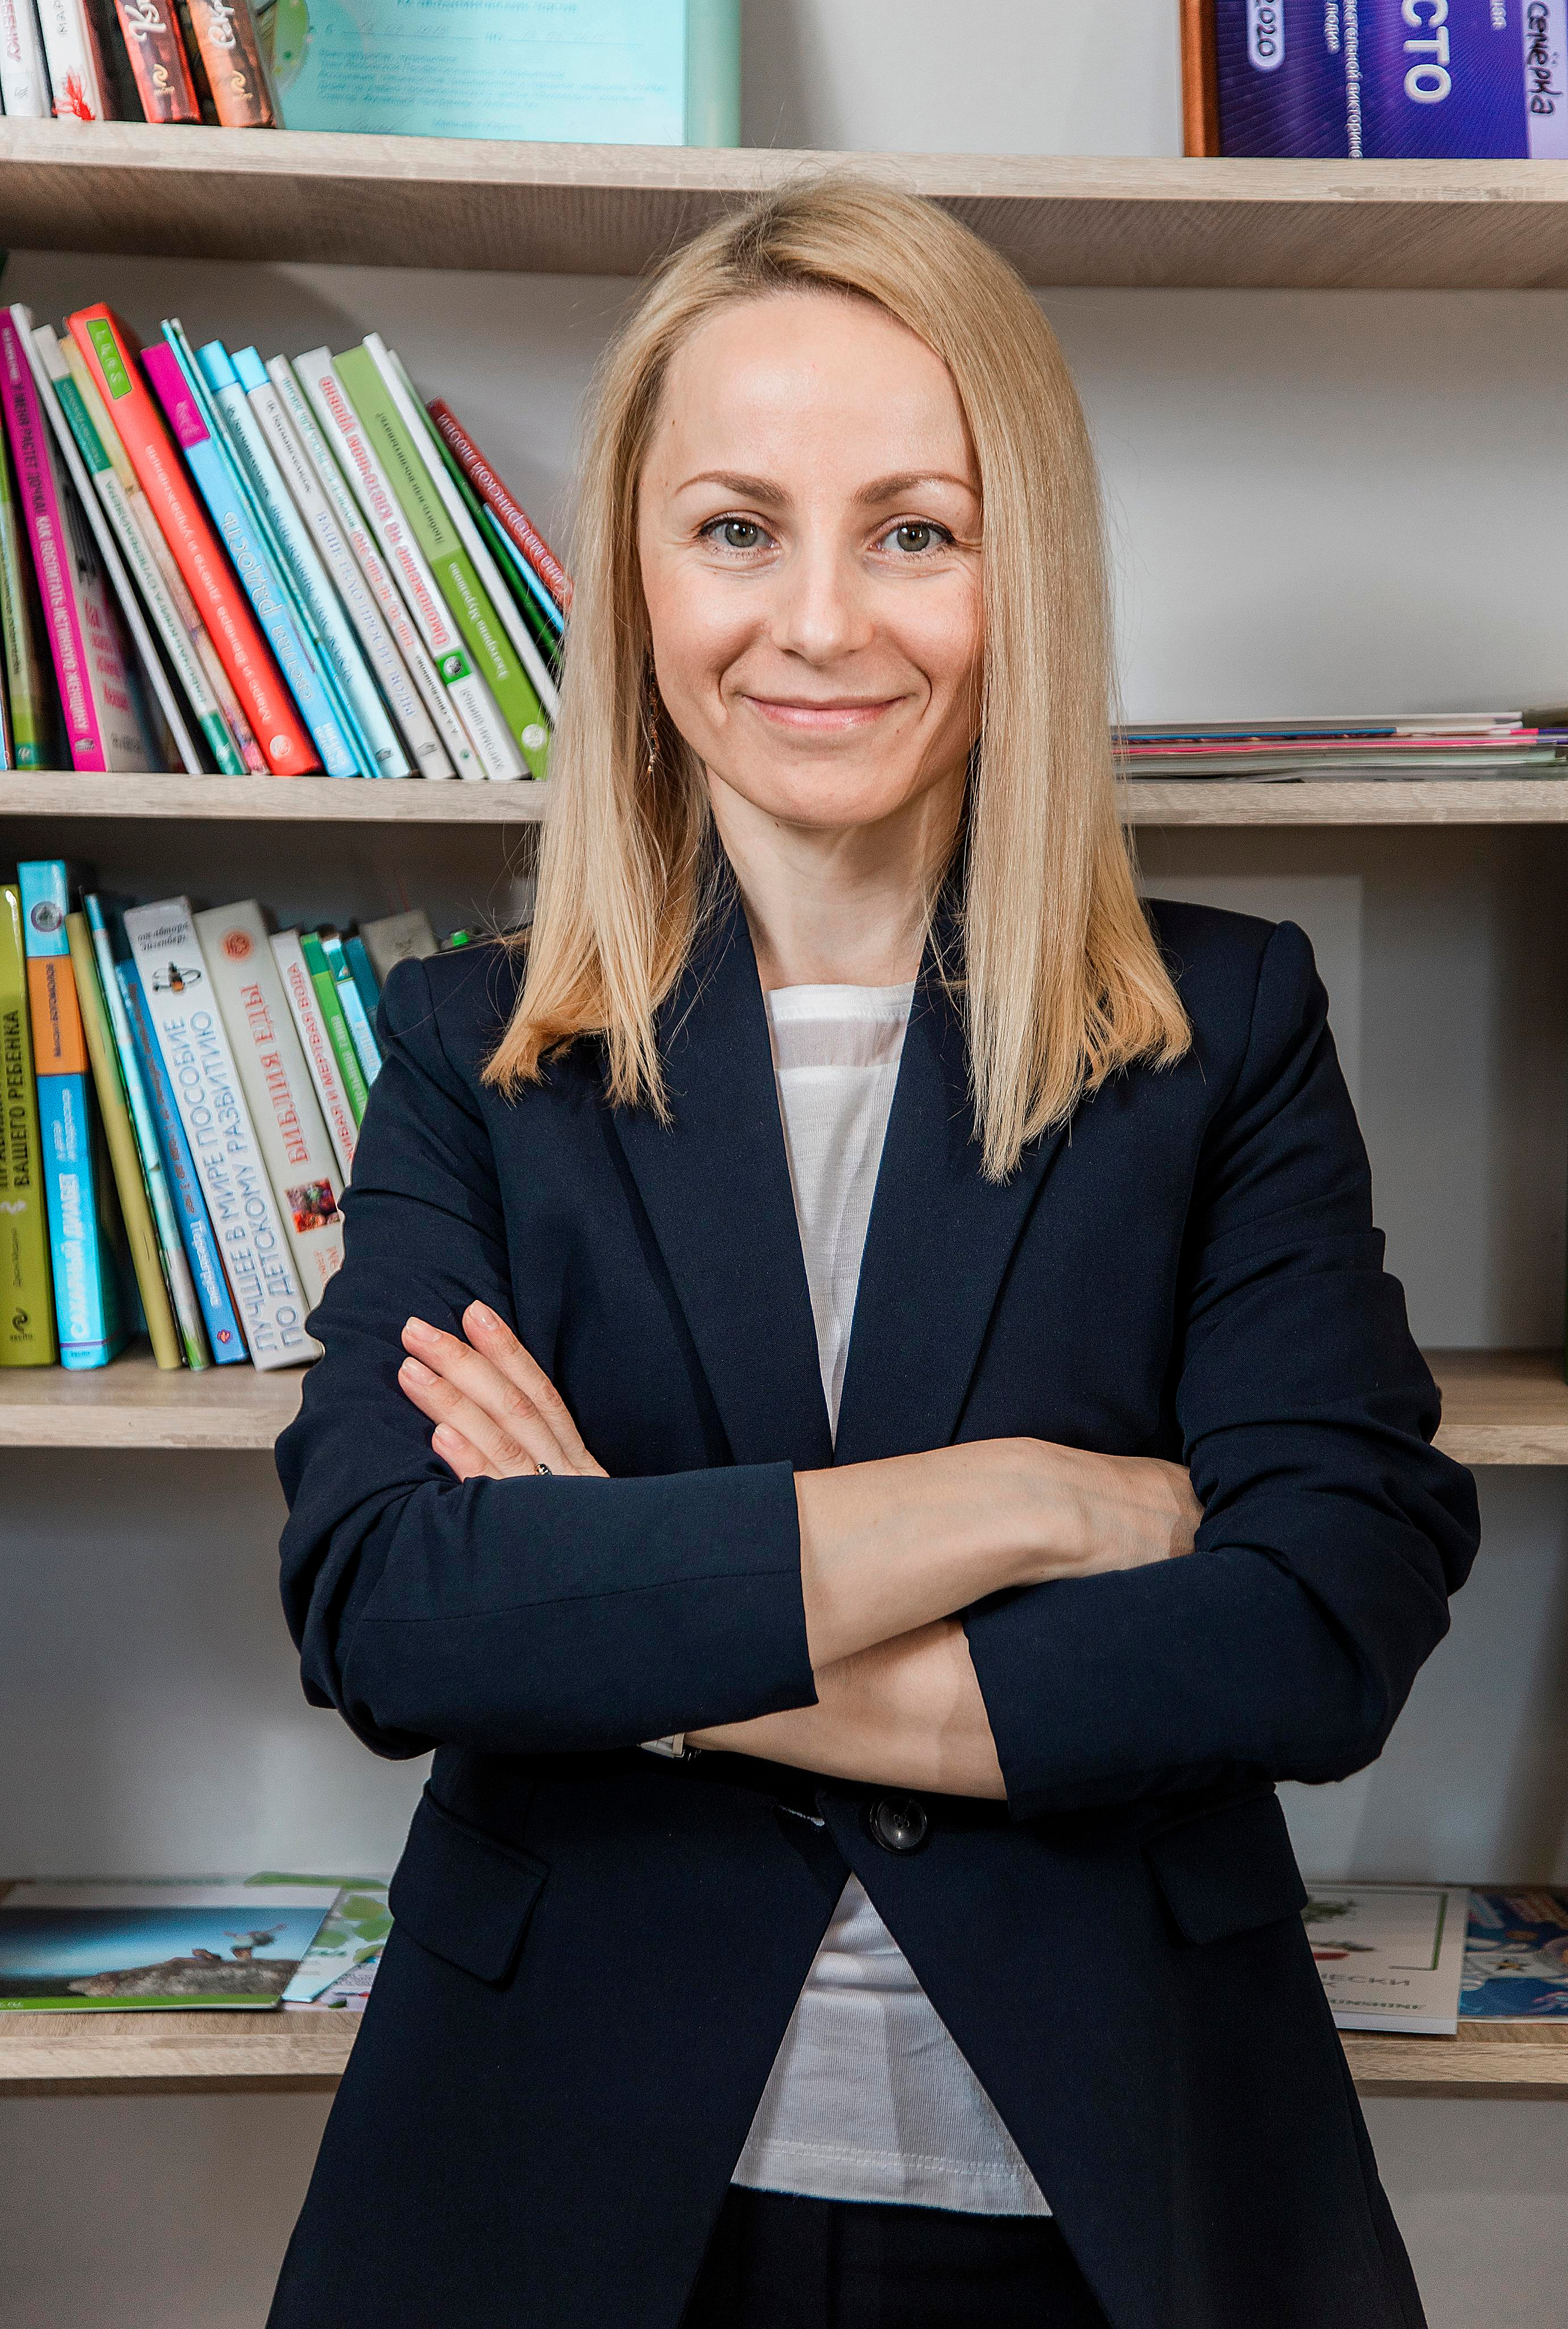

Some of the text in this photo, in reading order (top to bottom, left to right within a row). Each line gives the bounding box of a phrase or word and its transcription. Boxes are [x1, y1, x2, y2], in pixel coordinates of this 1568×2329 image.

[101, 478, 159, 591] СУПЕРВАЙЗЕРА
[140, 442, 196, 539] упражнения
[315, 373, 452, 649] Омоложение на клеточном уровне
[408, 481, 427, 504] или
[434, 411, 572, 595] ила материнской любви
[184, 538, 198, 551] и
[187, 547, 224, 602] диета
[213, 507, 282, 620] радость
[151, 590, 179, 639] КНИГА
[210, 605, 249, 666] Венера
[313, 509, 418, 718] ВАШЕ ТЕЛО ПРОСИТ ВОДЫ
[442, 560, 513, 680] Екатерина Мурашова
[239, 665, 254, 678] и
[243, 678, 274, 722] Марс
[283, 960, 314, 1011] ВОДА
[159, 1014, 219, 1148] ПОСОБИЕ
[235, 981, 314, 1168] БИБЛИЯ ЕДЫ
[298, 1010, 338, 1087] МЕРТВАЯ
[323, 1085, 340, 1103] И
[3, 1010, 30, 1189] ВАШЕГО РЕБЕНКА
[184, 1008, 306, 1349] ПО ДЕТСКОМУ РАЗВИТИЮ
[199, 1150, 241, 1223] МИРЕ
[56, 1171, 91, 1340] САХАРНЫЙ ДИАБЕТ
[222, 1223, 247, 1244] В
[227, 1245, 281, 1356] ЛУЧШЕЕ
